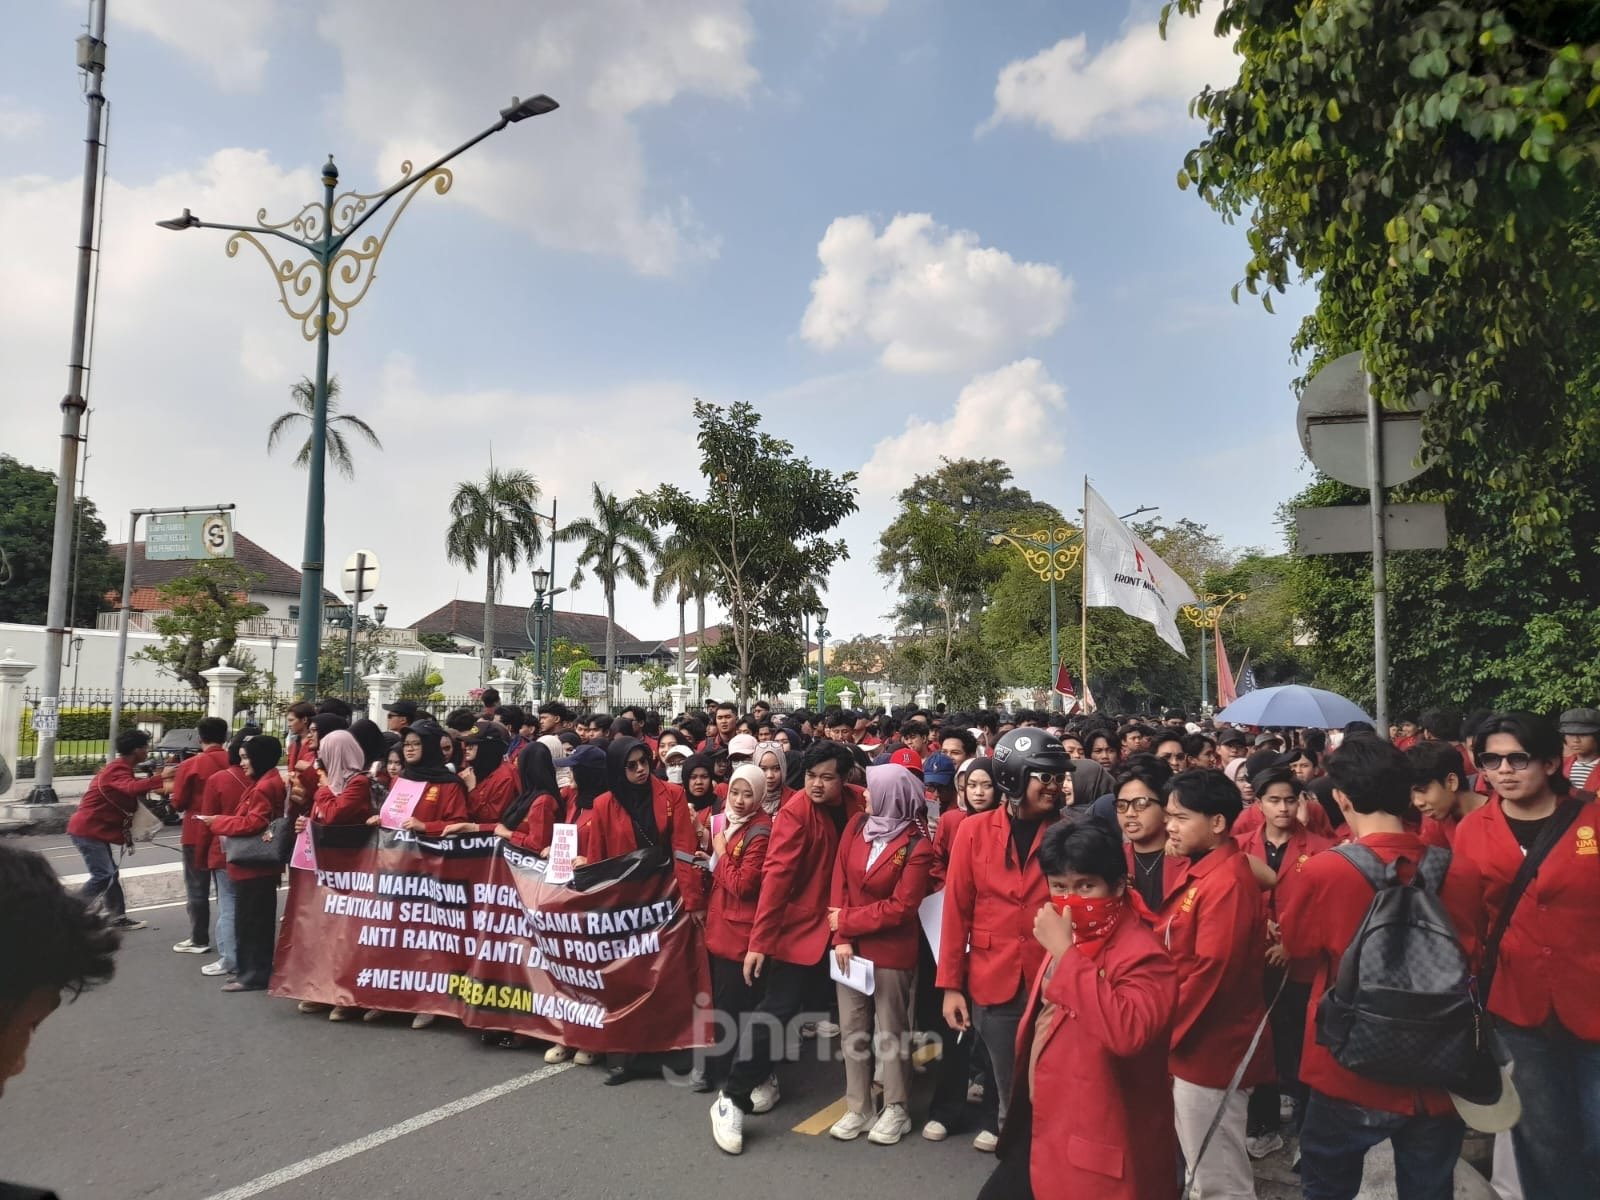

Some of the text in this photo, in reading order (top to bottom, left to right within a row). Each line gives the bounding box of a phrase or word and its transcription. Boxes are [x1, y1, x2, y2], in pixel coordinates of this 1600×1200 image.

[1114, 573, 1143, 587] FRONT
[317, 871, 374, 892] PEMUDA
[378, 874, 467, 904] MAHASISWA
[588, 901, 673, 935] RAKYAT!
[324, 895, 393, 920] HENTIKAN
[399, 902, 465, 930] SELURUH
[564, 931, 660, 964] PROGRAM
[358, 926, 397, 947] ANTI
[402, 929, 460, 953] RAKYAT
[478, 940, 523, 965] ANTI
